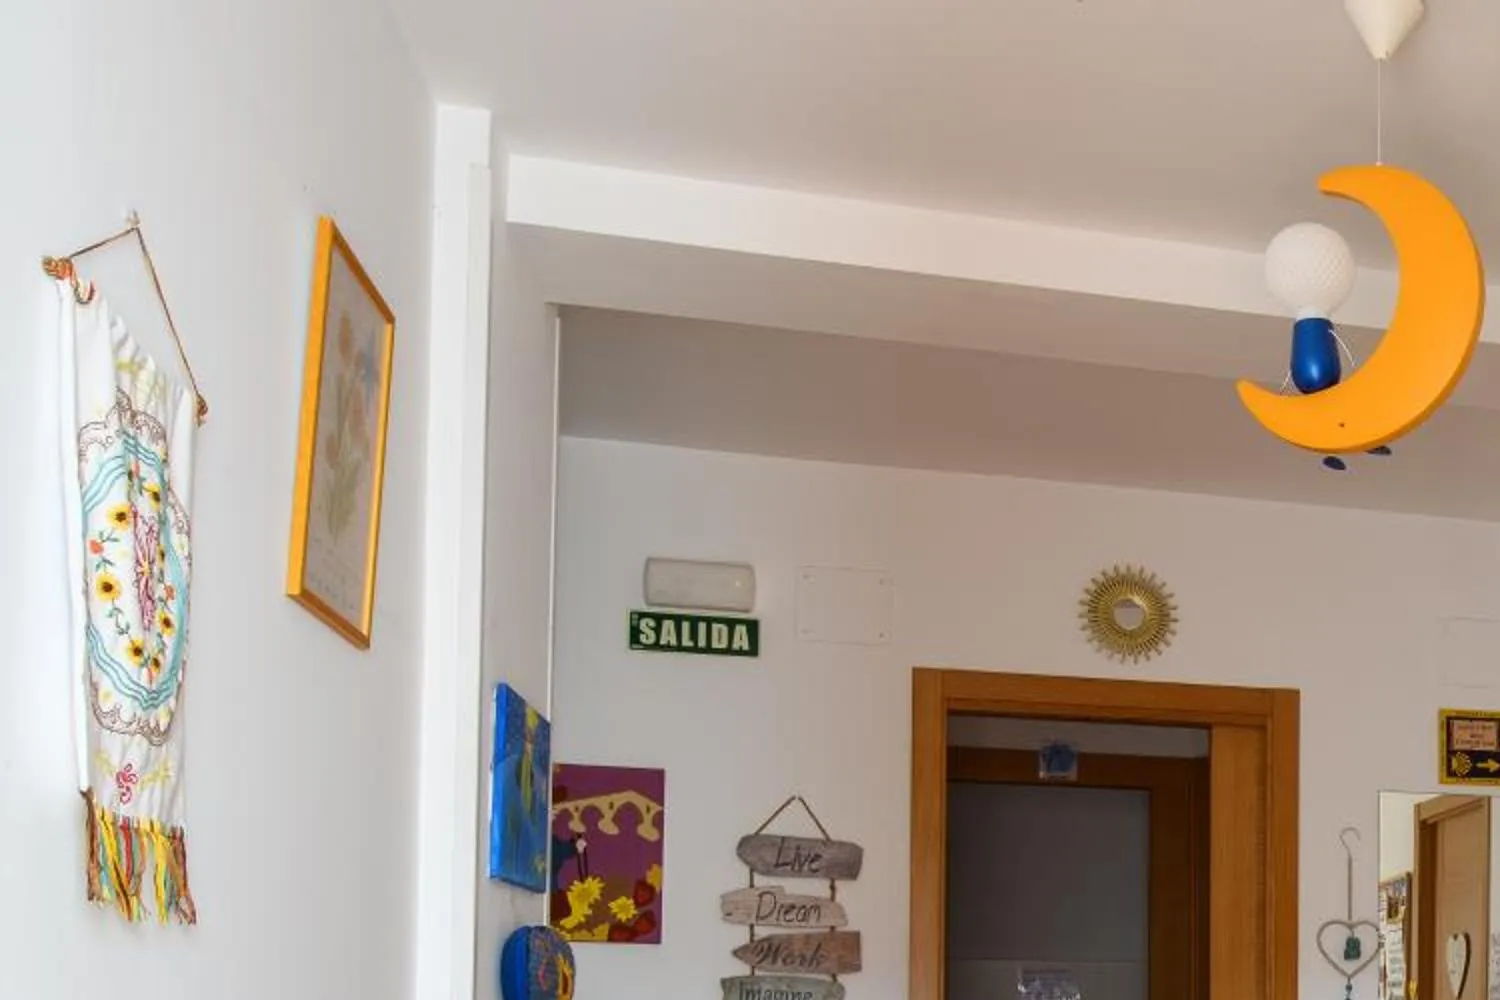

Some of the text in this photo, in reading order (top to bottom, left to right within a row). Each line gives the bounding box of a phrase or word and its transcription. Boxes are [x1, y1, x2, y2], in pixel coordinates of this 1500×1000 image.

[639, 617, 749, 650] SALIDA
[774, 836, 823, 873] Live
[756, 890, 822, 923] Dream
